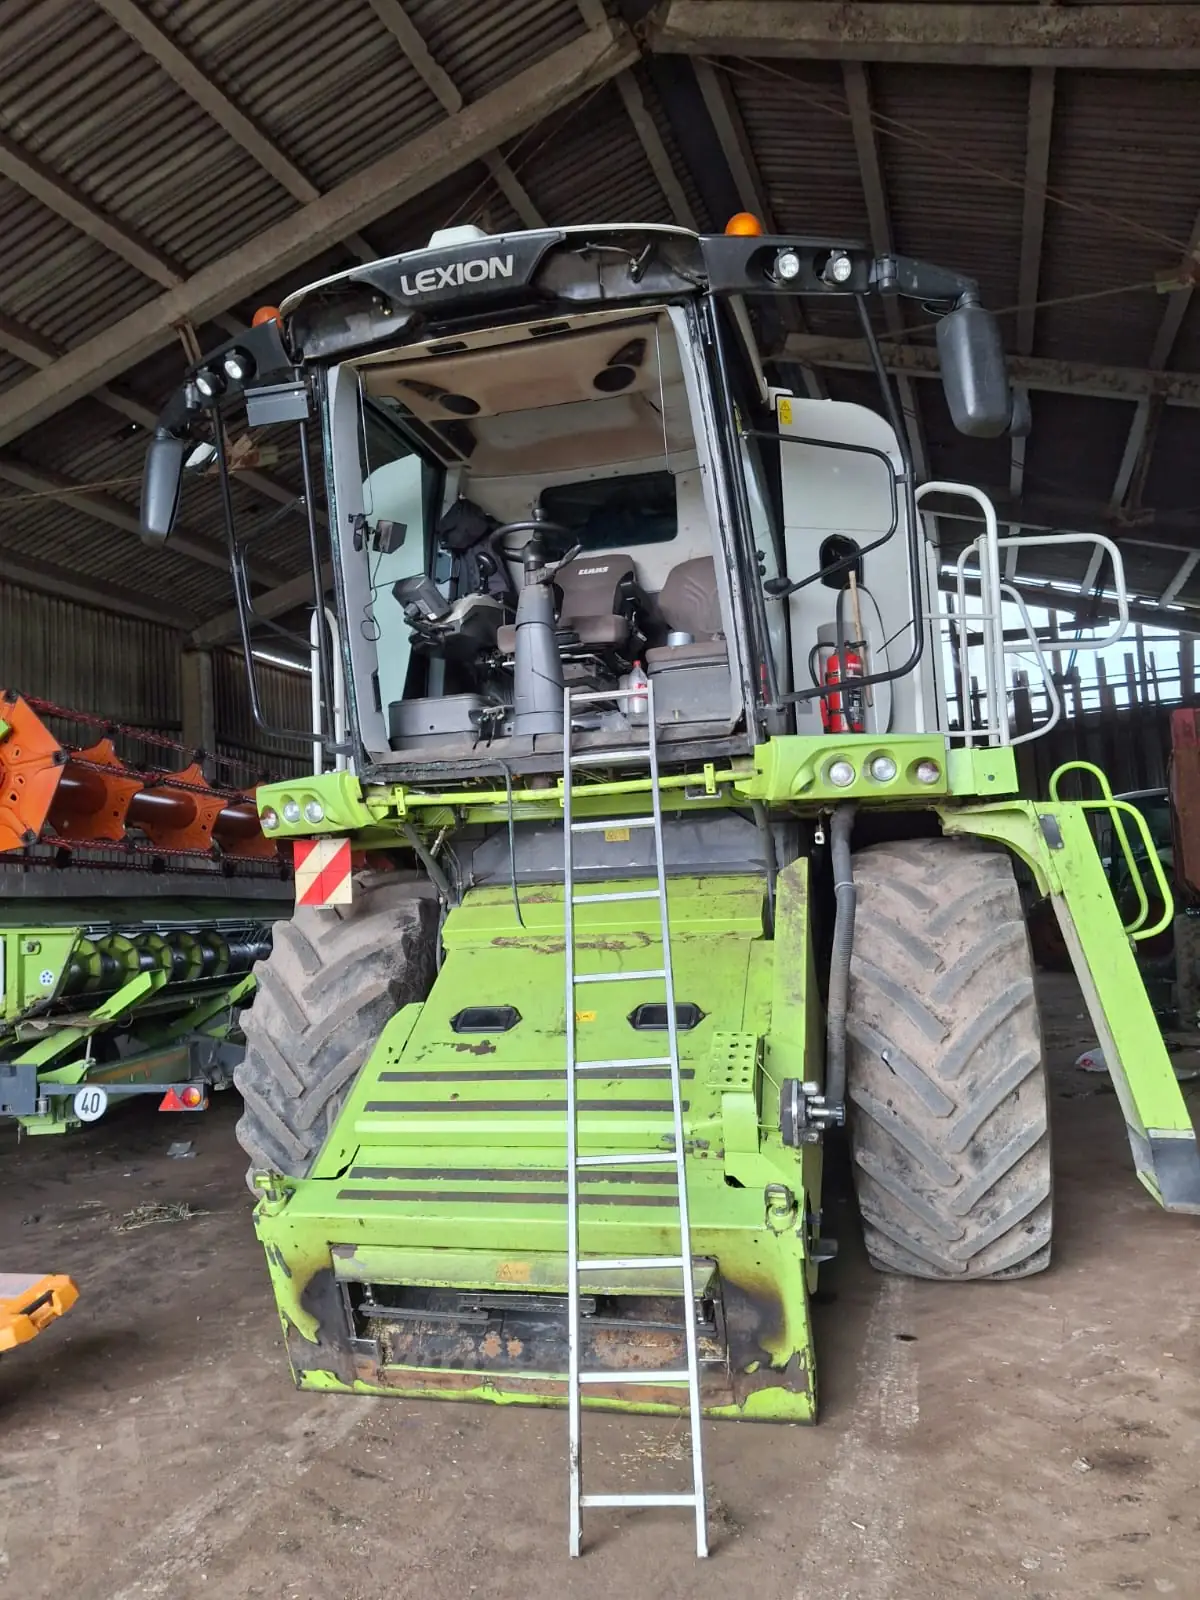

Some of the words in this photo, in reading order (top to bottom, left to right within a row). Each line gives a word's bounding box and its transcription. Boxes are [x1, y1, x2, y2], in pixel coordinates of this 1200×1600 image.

[401, 255, 513, 296] LEXION
[578, 566, 609, 575] CLAAS
[81, 1093, 100, 1114] 40
